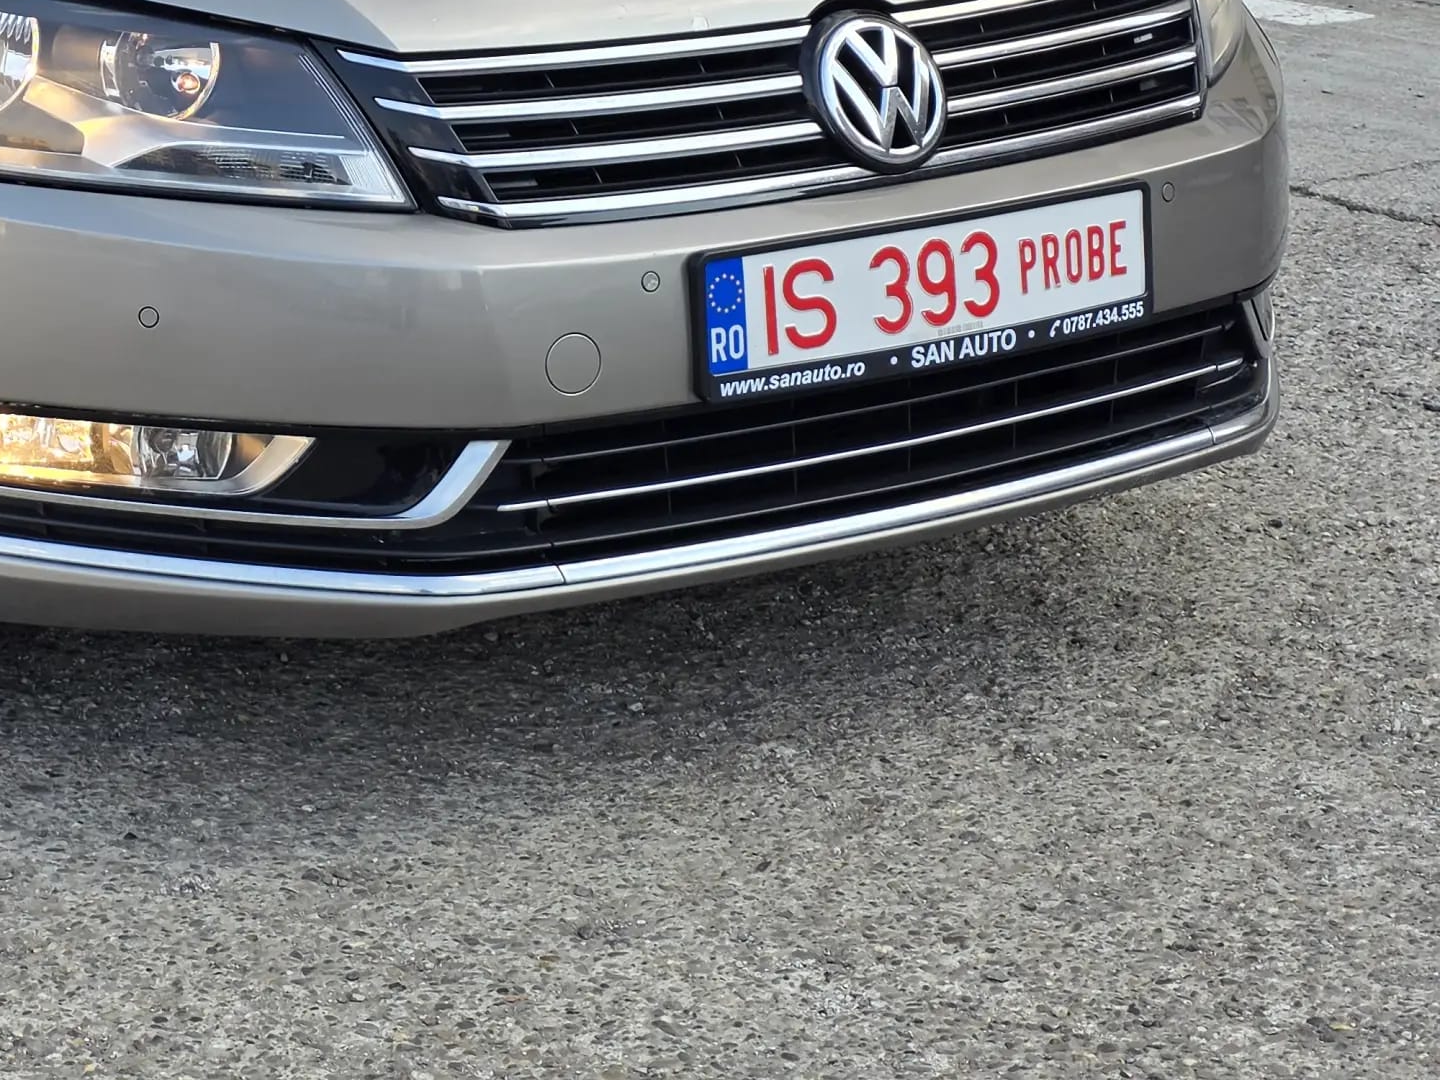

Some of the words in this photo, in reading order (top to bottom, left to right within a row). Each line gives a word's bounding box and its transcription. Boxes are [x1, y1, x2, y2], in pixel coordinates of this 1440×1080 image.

[762, 257, 837, 356] IS
[869, 230, 1000, 335] 393
[1018, 220, 1128, 295] PROBE
[710, 324, 745, 363] RO
[720, 361, 866, 397] www.sanauto.ro
[911, 340, 954, 368] SAN
[958, 329, 1016, 359] AUTO
[1063, 301, 1144, 334] 0787.434.555
